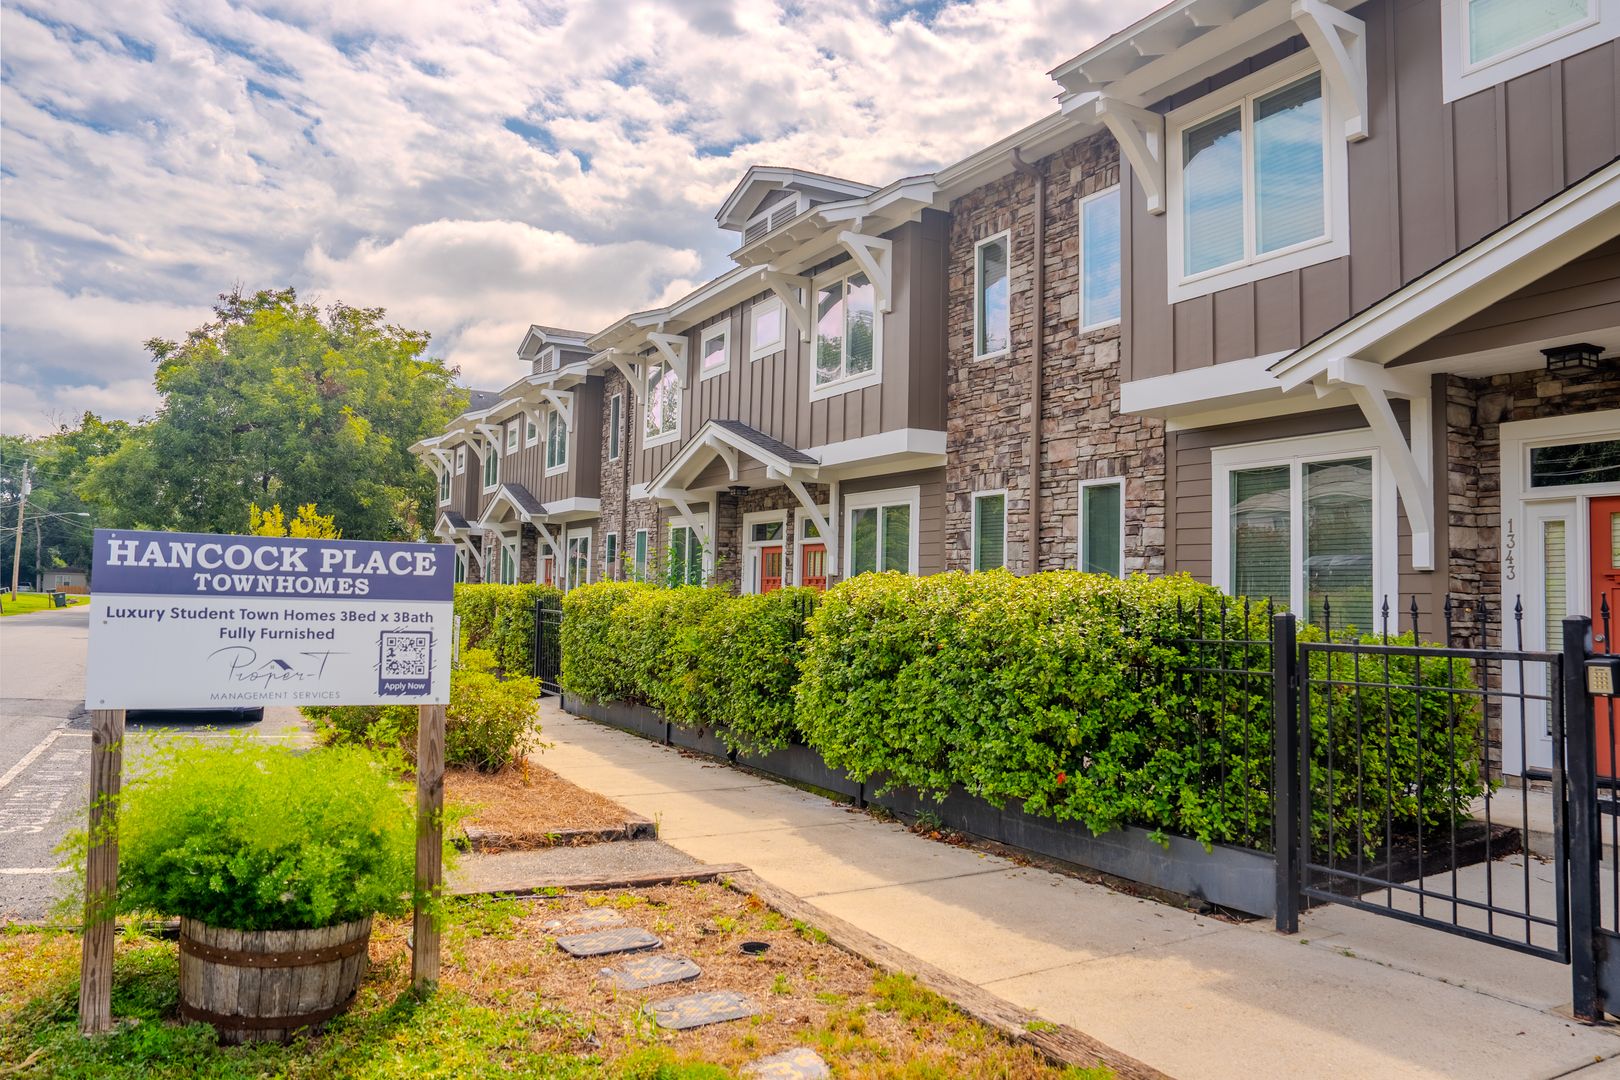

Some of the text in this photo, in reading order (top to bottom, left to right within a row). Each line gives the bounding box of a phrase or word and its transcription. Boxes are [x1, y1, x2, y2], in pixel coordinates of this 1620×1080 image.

[106, 539, 437, 576] HANCOCK PLACE
[1505, 518, 1516, 580] 1343
[193, 572, 370, 595] TOWNHOMES
[106, 606, 434, 623] Luxury Student Town Homes 3Bed x 3Bath
[219, 627, 335, 642] Fully Furnished
[384, 682, 426, 691] Apply Now
[210, 691, 340, 700] MANAGEMENT SERVICES
